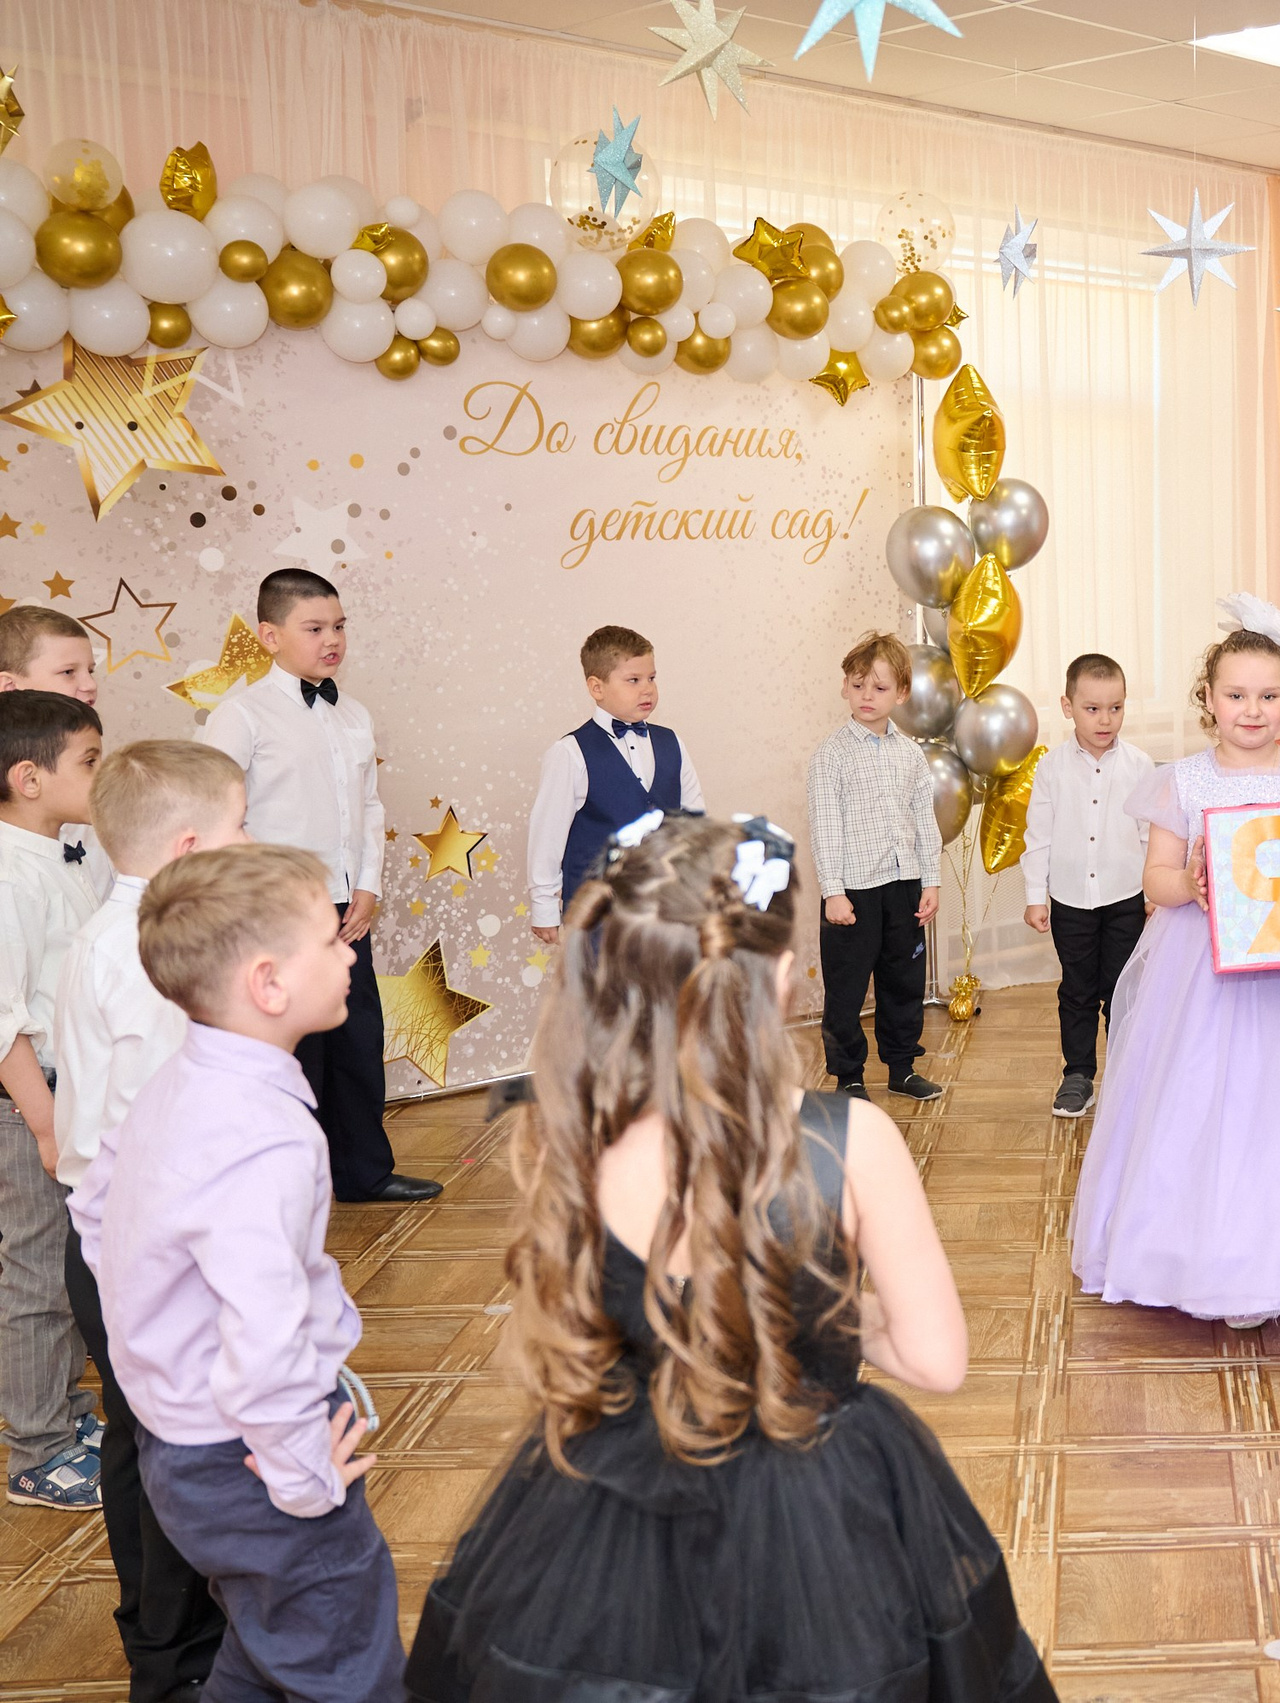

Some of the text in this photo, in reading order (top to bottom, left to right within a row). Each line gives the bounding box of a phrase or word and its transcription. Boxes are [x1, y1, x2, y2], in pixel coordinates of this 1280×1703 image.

[459, 380, 803, 483] До свидания,
[560, 488, 870, 569] детский сад!
[18, 1475, 35, 1493] 58
